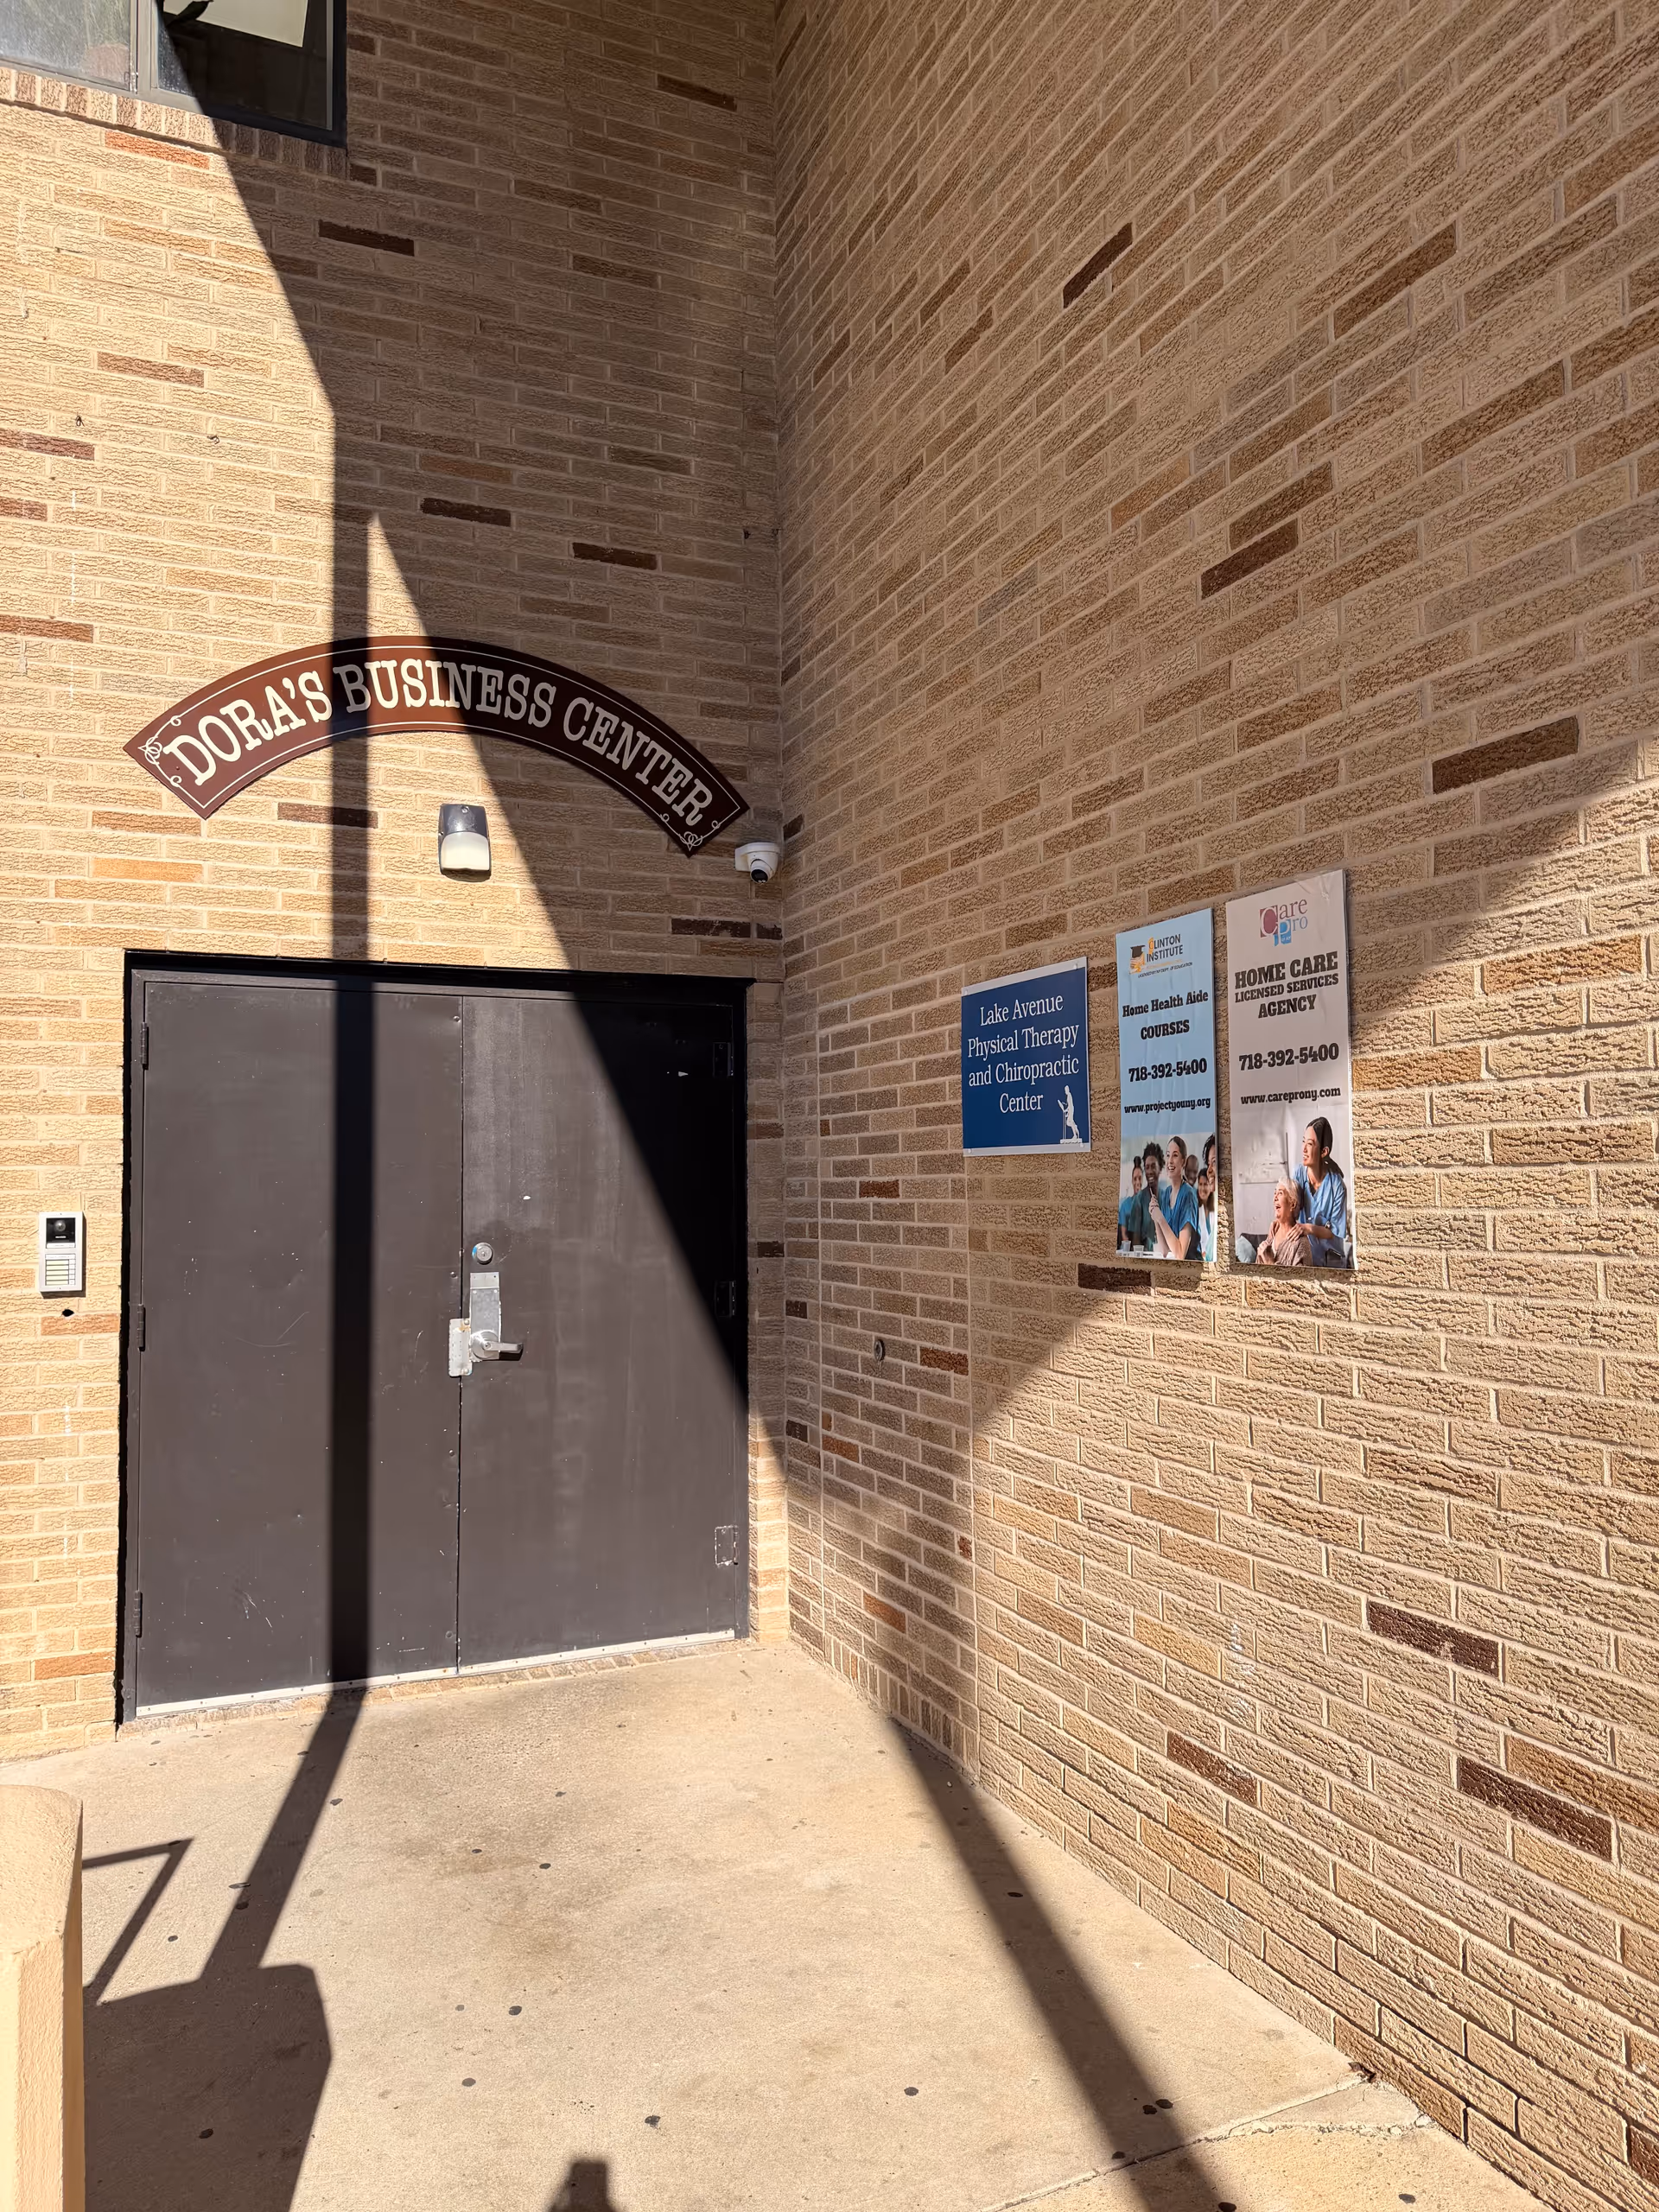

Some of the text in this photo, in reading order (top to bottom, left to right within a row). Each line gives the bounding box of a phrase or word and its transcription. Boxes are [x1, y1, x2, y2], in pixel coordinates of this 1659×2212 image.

[163, 660, 714, 828] DORA'S BUSINESS CENTER
[1147, 944, 1183, 963] INSTITUTE
[1149, 933, 1181, 950] CLINTON
[1235, 950, 1338, 989] HOME CARE
[1235, 973, 1339, 1003] LICENSED SERVICES
[980, 995, 1064, 1027] Lake Avenue
[1122, 989, 1209, 1017] Home Health Aide
[1258, 994, 1317, 1019] AGENCY
[968, 1024, 1079, 1061] Physical Therapy
[1141, 1019, 1190, 1040] COURSES
[1239, 1042, 1339, 1071] 718-392-5400
[969, 1054, 1079, 1087] and Chiropractic
[1128, 1058, 1208, 1083] 718-392-5400
[1000, 1091, 1044, 1114] Center
[1124, 1097, 1211, 1114] www.projectyouny.org
[1241, 1087, 1341, 1105] www.careprony.com
